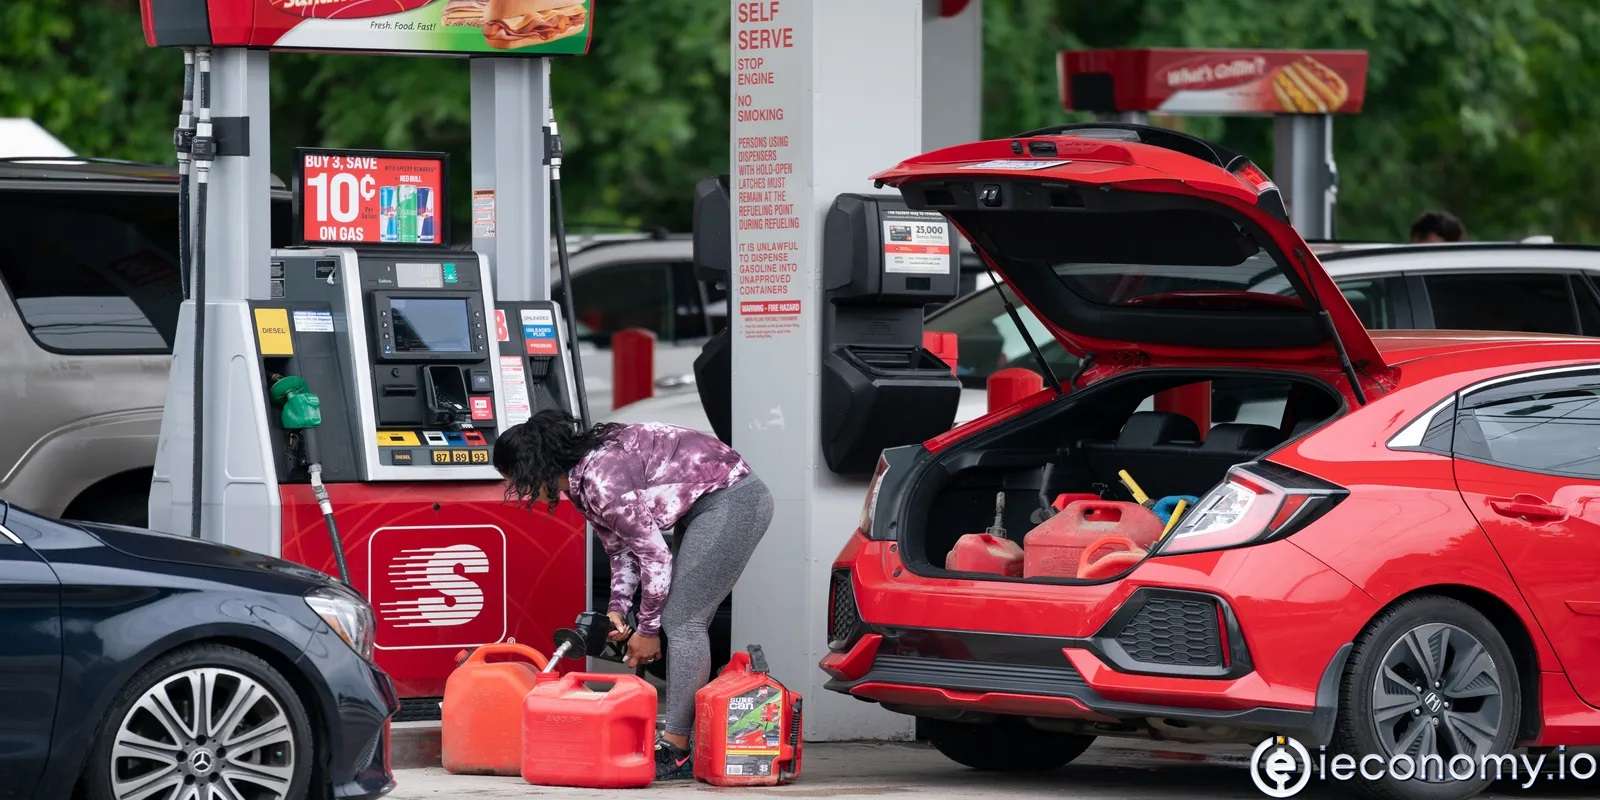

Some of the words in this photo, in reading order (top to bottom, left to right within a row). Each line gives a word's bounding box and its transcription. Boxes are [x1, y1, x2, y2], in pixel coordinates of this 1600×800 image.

[738, 1, 779, 23] SELF
[370, 21, 392, 30] Fresh.
[394, 22, 415, 30] Food.
[417, 22, 437, 31] Fast!
[738, 27, 793, 50] SERVE
[737, 57, 764, 71] STOP
[738, 72, 774, 86] ENGINE
[738, 95, 752, 107] NO
[738, 108, 784, 122] SMOKING
[738, 137, 767, 149] PERSONS
[768, 136, 789, 147] USING
[739, 150, 777, 162] DISPENSERS
[305, 155, 329, 168] BUY
[332, 156, 344, 171] 3,
[346, 156, 377, 170] SAVE
[739, 164, 755, 176] WITH
[756, 163, 792, 175] HOLD-OPEN
[739, 178, 766, 190] LATCHES
[767, 177, 785, 188] MUST
[307, 172, 376, 223] 10¢
[739, 191, 763, 203] REMAIN
[764, 191, 773, 202] AT
[774, 190, 787, 202] THE
[738, 205, 773, 217] REFUELING
[774, 204, 794, 215] POINT
[738, 219, 763, 231] DURING
[764, 217, 799, 229] REFUELING
[916, 225, 943, 235] 25,000
[320, 226, 336, 240] ON
[340, 227, 364, 241] GAS
[739, 243, 746, 252] IT
[747, 243, 755, 252] IS
[757, 242, 798, 252] UNLAWFUL
[739, 254, 749, 263] TO
[751, 253, 788, 262] DISPENSE
[740, 264, 777, 274] GASOLINE
[779, 263, 798, 273] INTO
[740, 274, 791, 285] UNAPPROVED
[740, 285, 788, 296] CONTAINERS
[768, 304, 779, 312] FIRE
[780, 303, 800, 312] HAZARD
[436, 453, 447, 462] 87
[455, 453, 467, 462] 89
[474, 453, 485, 462] 93
[729, 702, 754, 710] can
